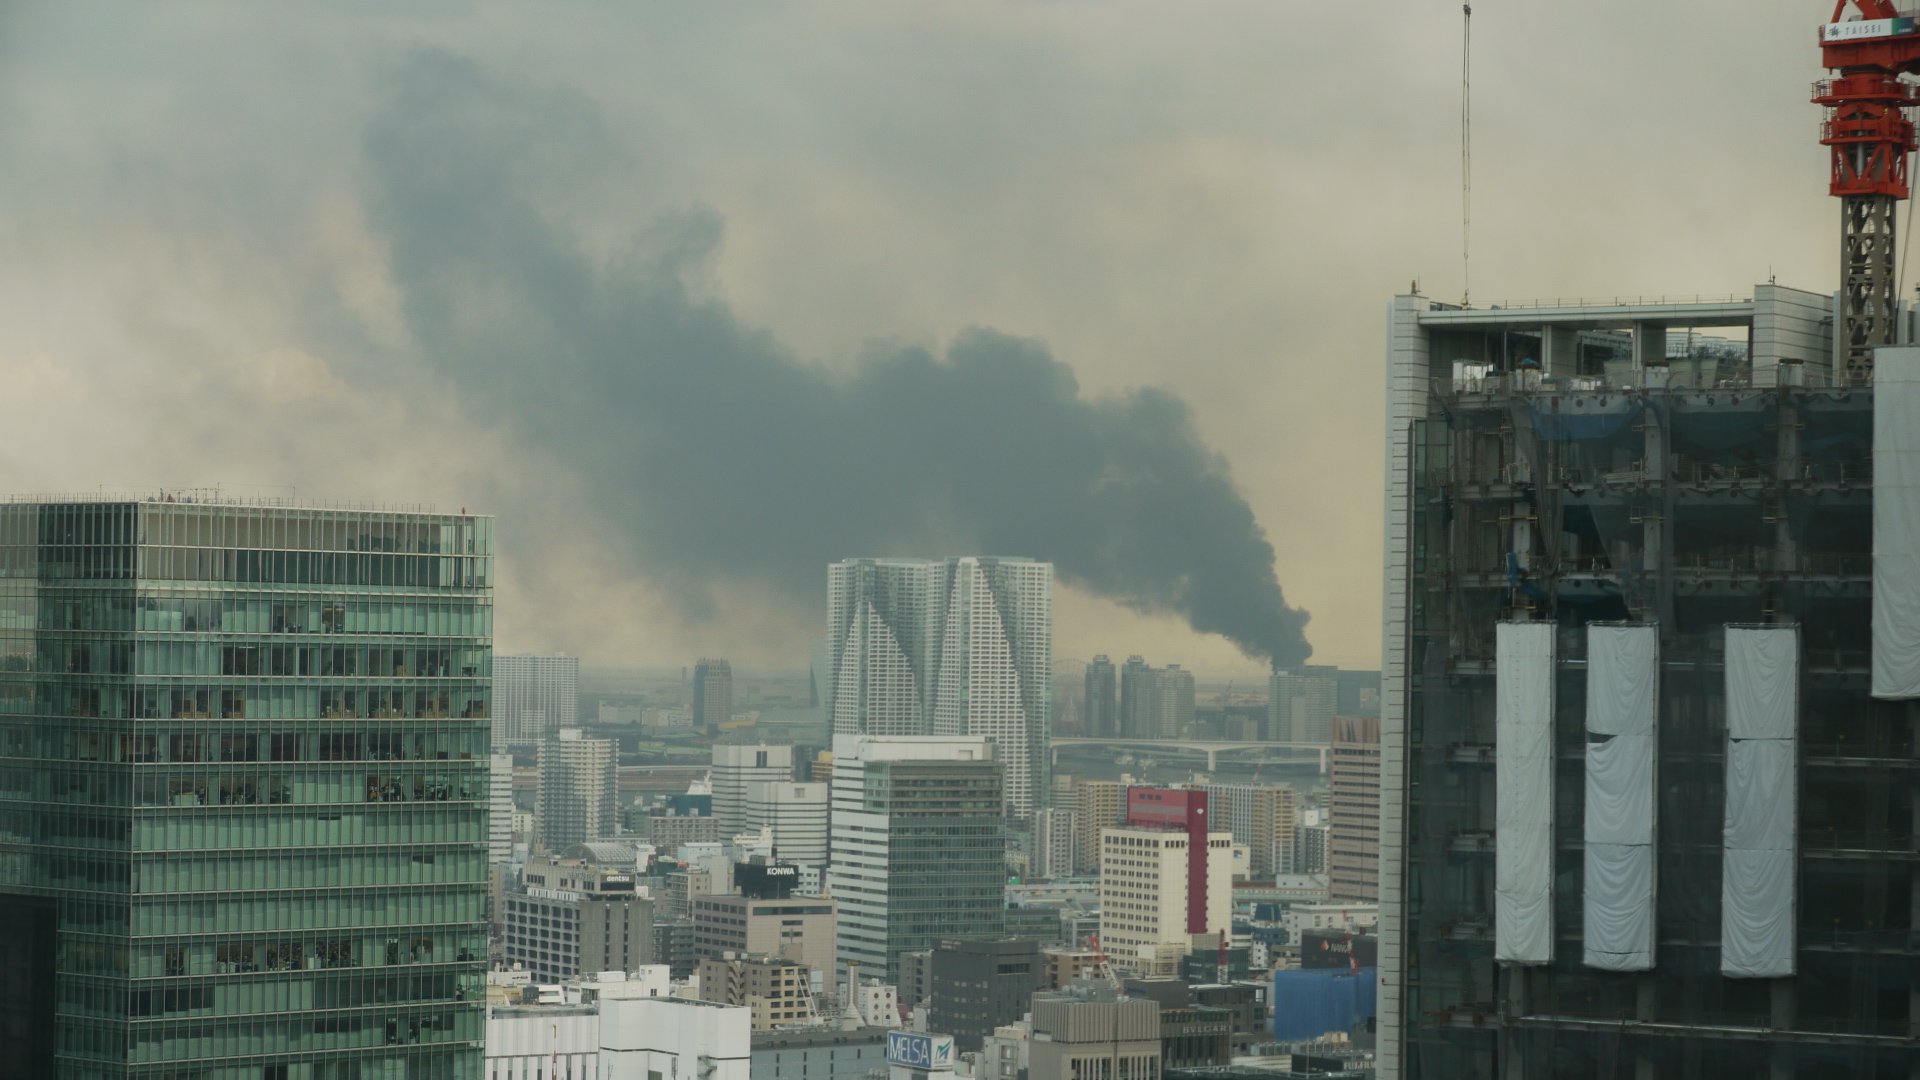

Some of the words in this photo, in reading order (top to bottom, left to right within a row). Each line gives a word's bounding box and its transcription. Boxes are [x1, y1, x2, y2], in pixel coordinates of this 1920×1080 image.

[1845, 24, 1881, 35] TAISEI
[1183, 1025, 1231, 1033] BVLGARI
[889, 1035, 930, 1065] MELSA
